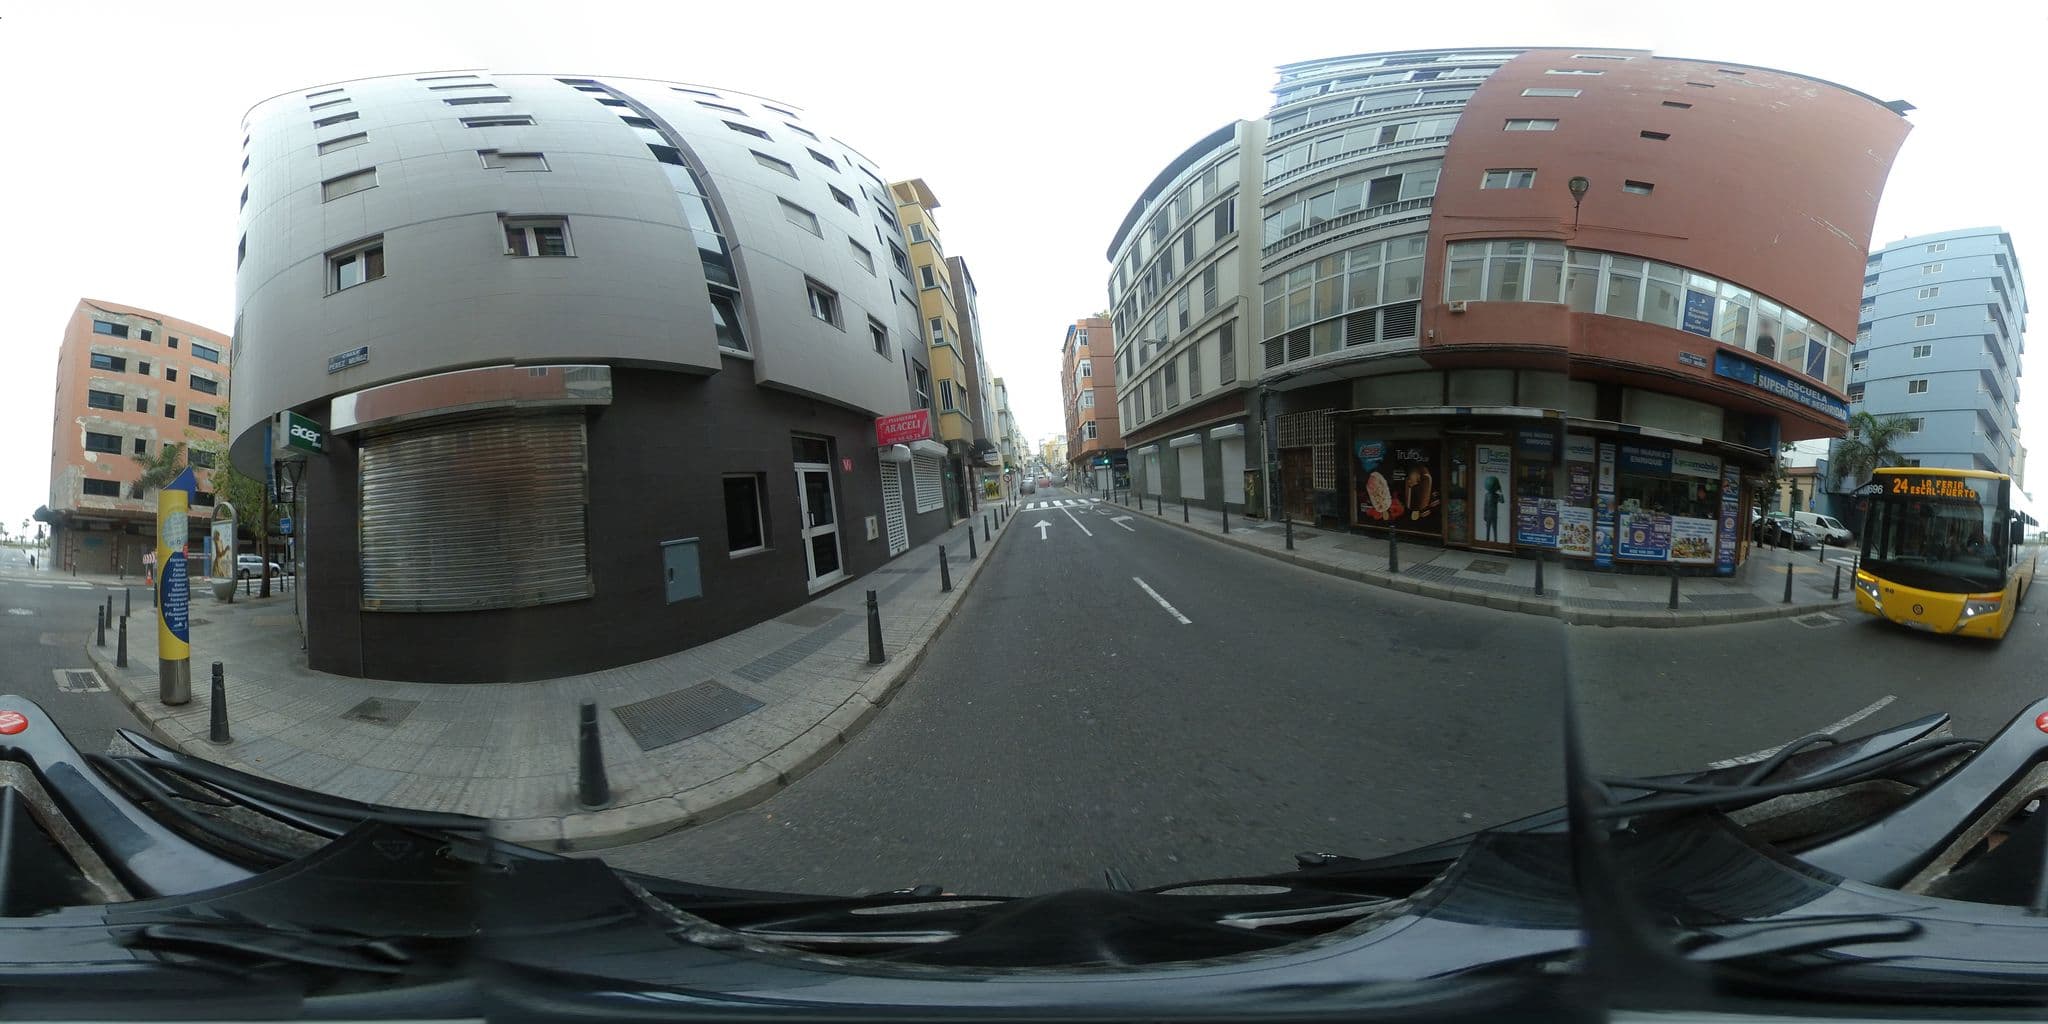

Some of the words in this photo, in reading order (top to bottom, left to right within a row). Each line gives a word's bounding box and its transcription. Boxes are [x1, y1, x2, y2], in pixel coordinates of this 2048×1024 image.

[1758, 374, 1799, 400] SUPERIOR
[1800, 395, 1810, 406] DE
[1811, 399, 1847, 421] SEGURIDAD
[1787, 380, 1828, 403] ESCUELA
[290, 424, 321, 442] acer
[885, 419, 921, 433] ARACELI
[1893, 478, 1908, 494] 24
[1910, 486, 1976, 498] ESCAL-PUERTO
[1921, 480, 1932, 488] LA
[1936, 480, 1964, 489] FERIA
